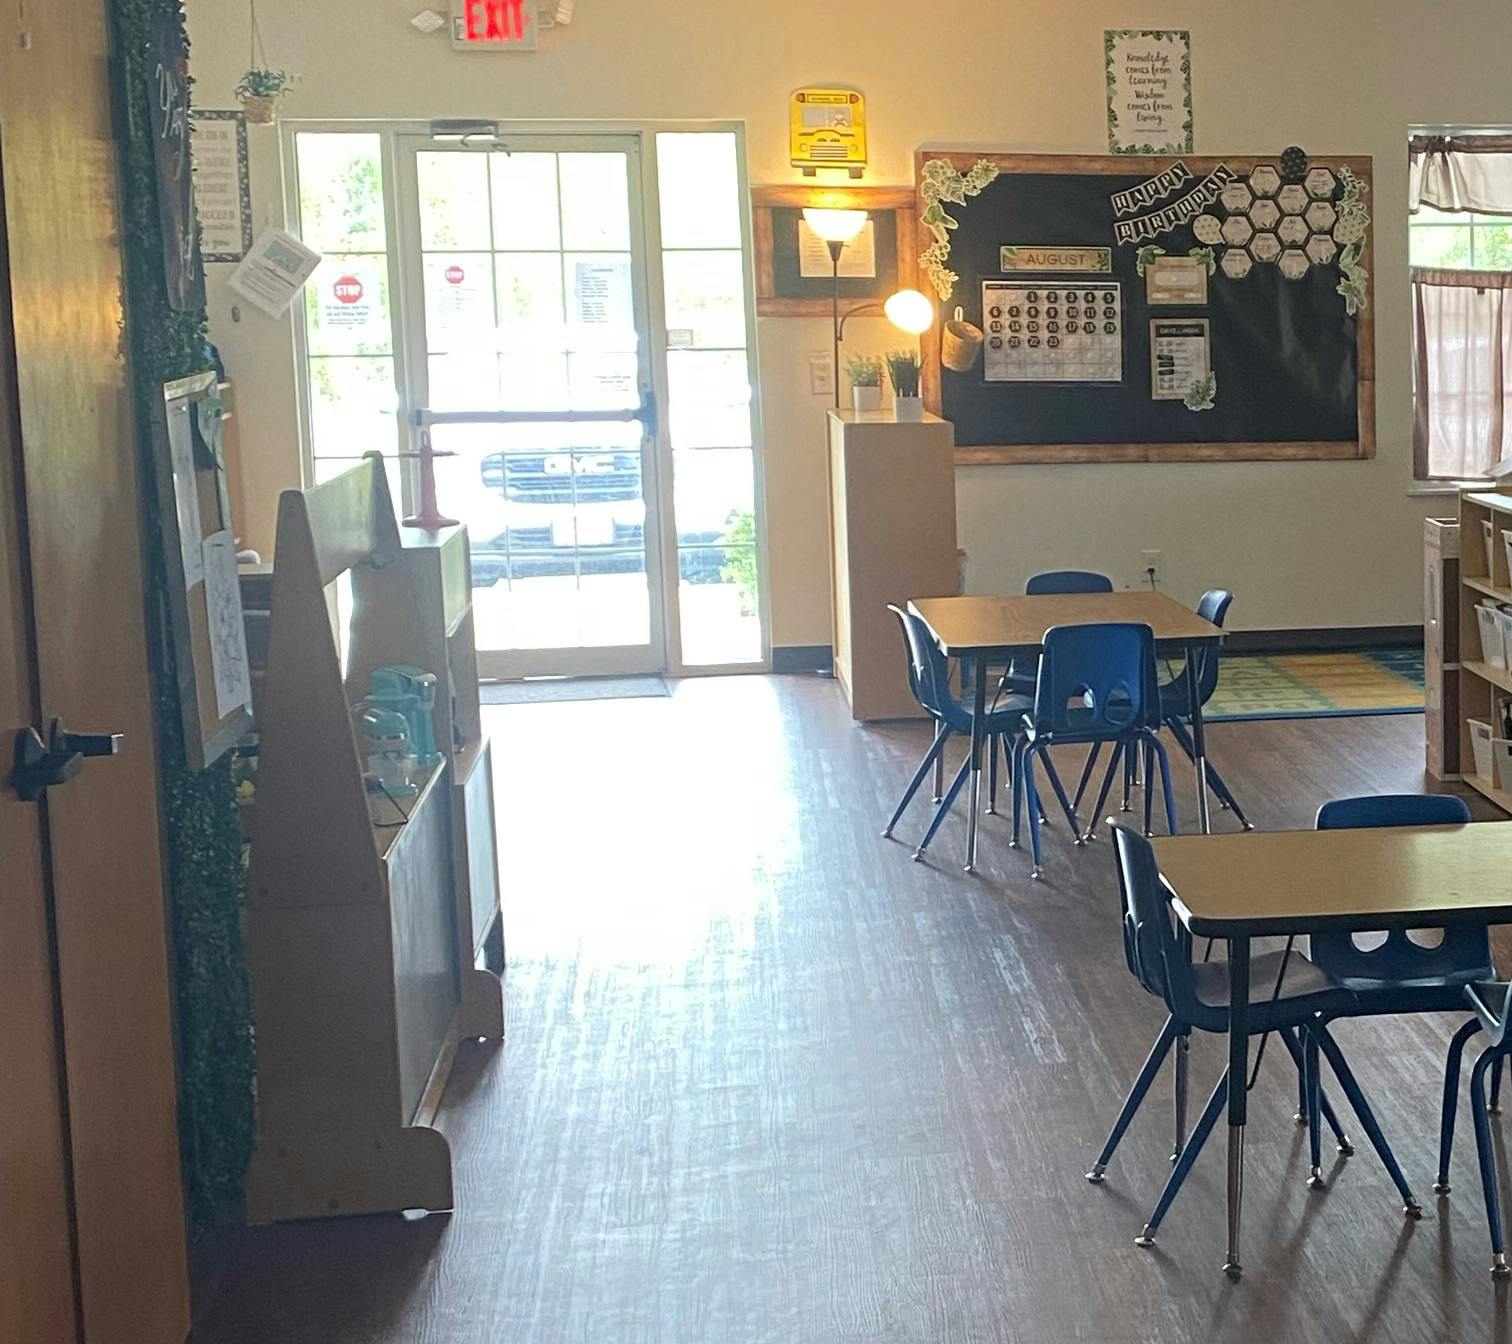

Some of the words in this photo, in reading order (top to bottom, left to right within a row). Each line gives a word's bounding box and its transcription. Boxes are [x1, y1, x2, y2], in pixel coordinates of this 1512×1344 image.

[1126, 52, 1169, 66] Knowledge
[1151, 63, 1172, 76] from
[1153, 100, 1173, 112] from
[1115, 165, 1187, 209] HAPPY
[1120, 167, 1228, 237] BIRTHDAY
[1026, 254, 1086, 265] AUGUST
[336, 284, 361, 296] STOP
